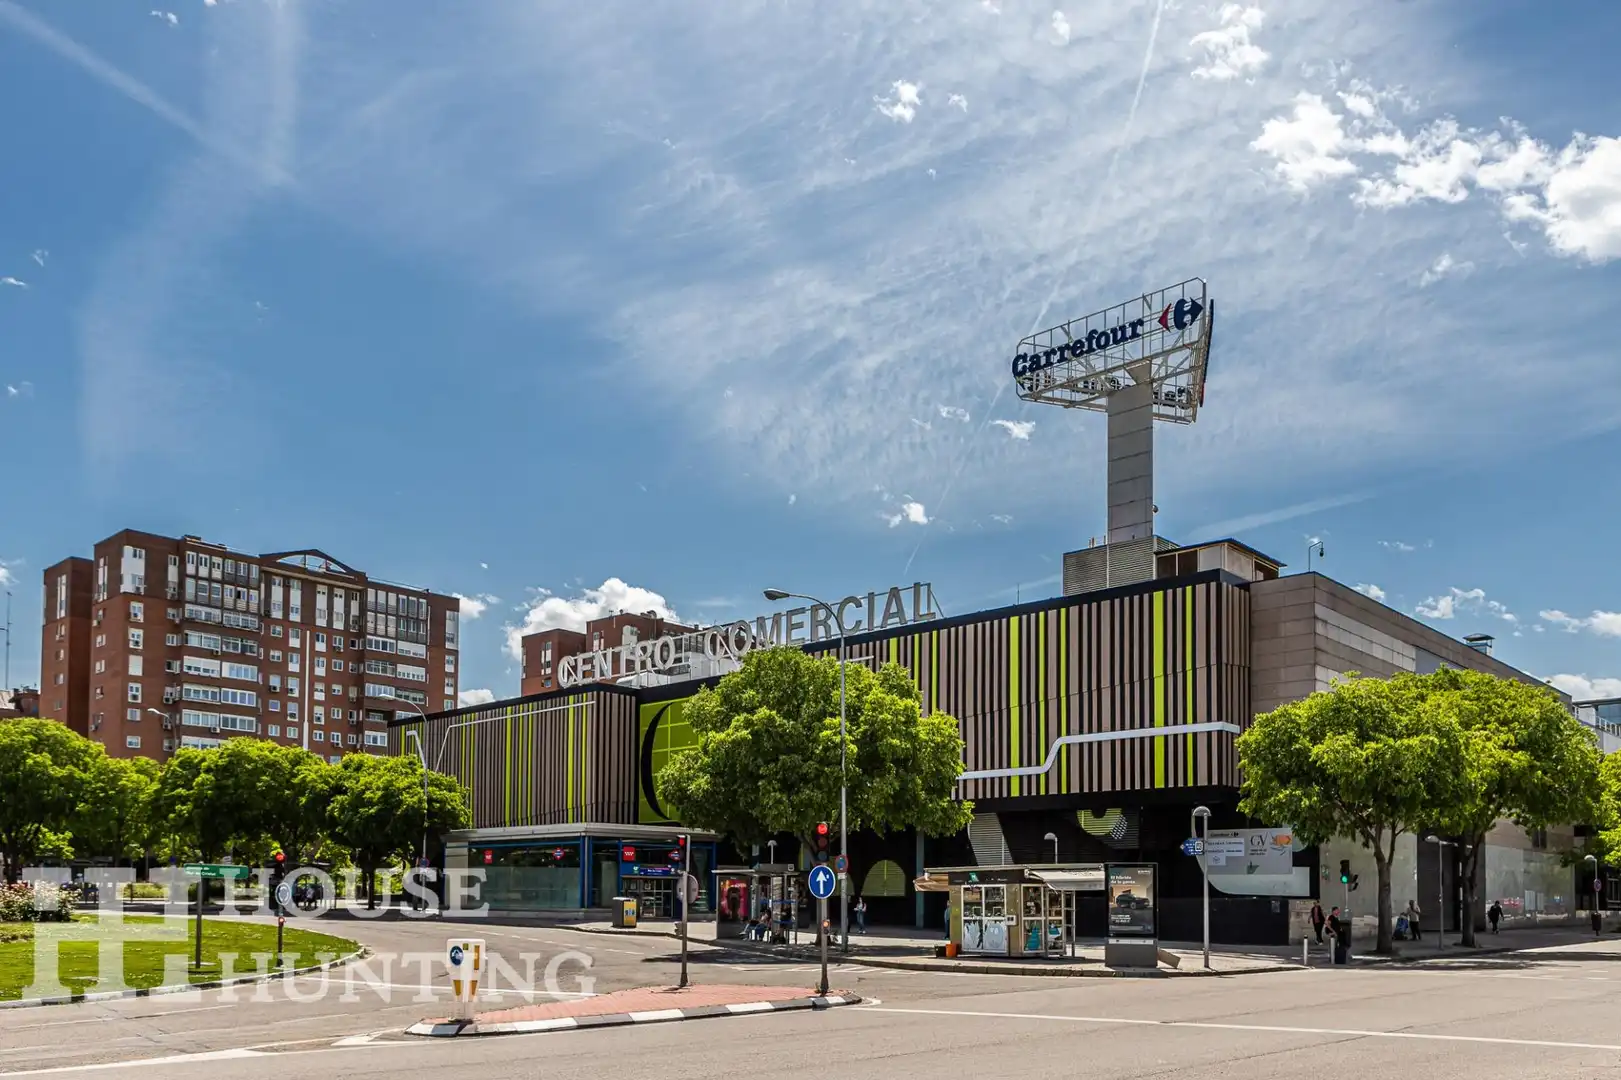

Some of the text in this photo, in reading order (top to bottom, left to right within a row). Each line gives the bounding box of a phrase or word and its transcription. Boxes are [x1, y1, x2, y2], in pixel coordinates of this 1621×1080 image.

[1012, 317, 1144, 378] Carrefour
[558, 582, 937, 689] CENTRO COMERCIAL
